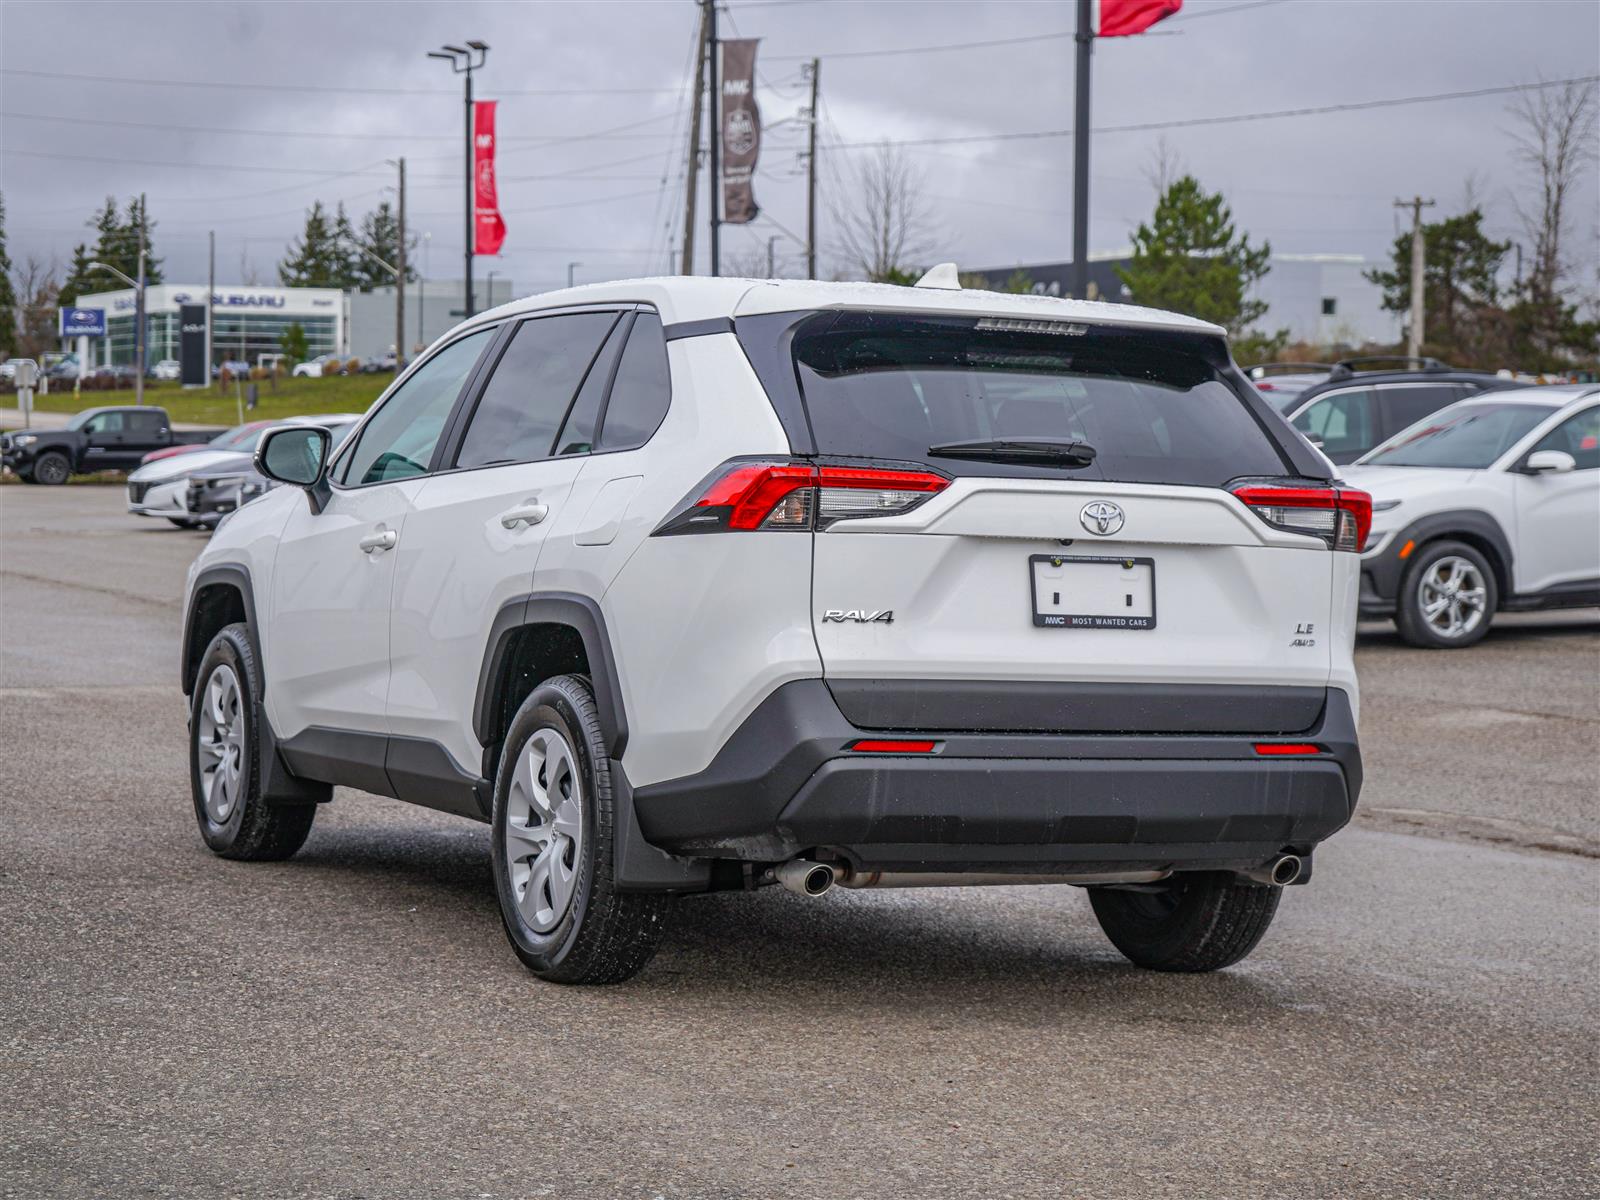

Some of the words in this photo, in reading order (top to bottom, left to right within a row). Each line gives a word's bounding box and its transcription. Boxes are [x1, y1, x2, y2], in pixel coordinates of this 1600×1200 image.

[211, 293, 285, 308] SUBARU
[822, 609, 895, 625] RAV4
[1072, 617, 1093, 625] MOST
[1095, 617, 1126, 626] WANTED
[1295, 623, 1314, 634] LE
[1289, 639, 1316, 647] AWD
